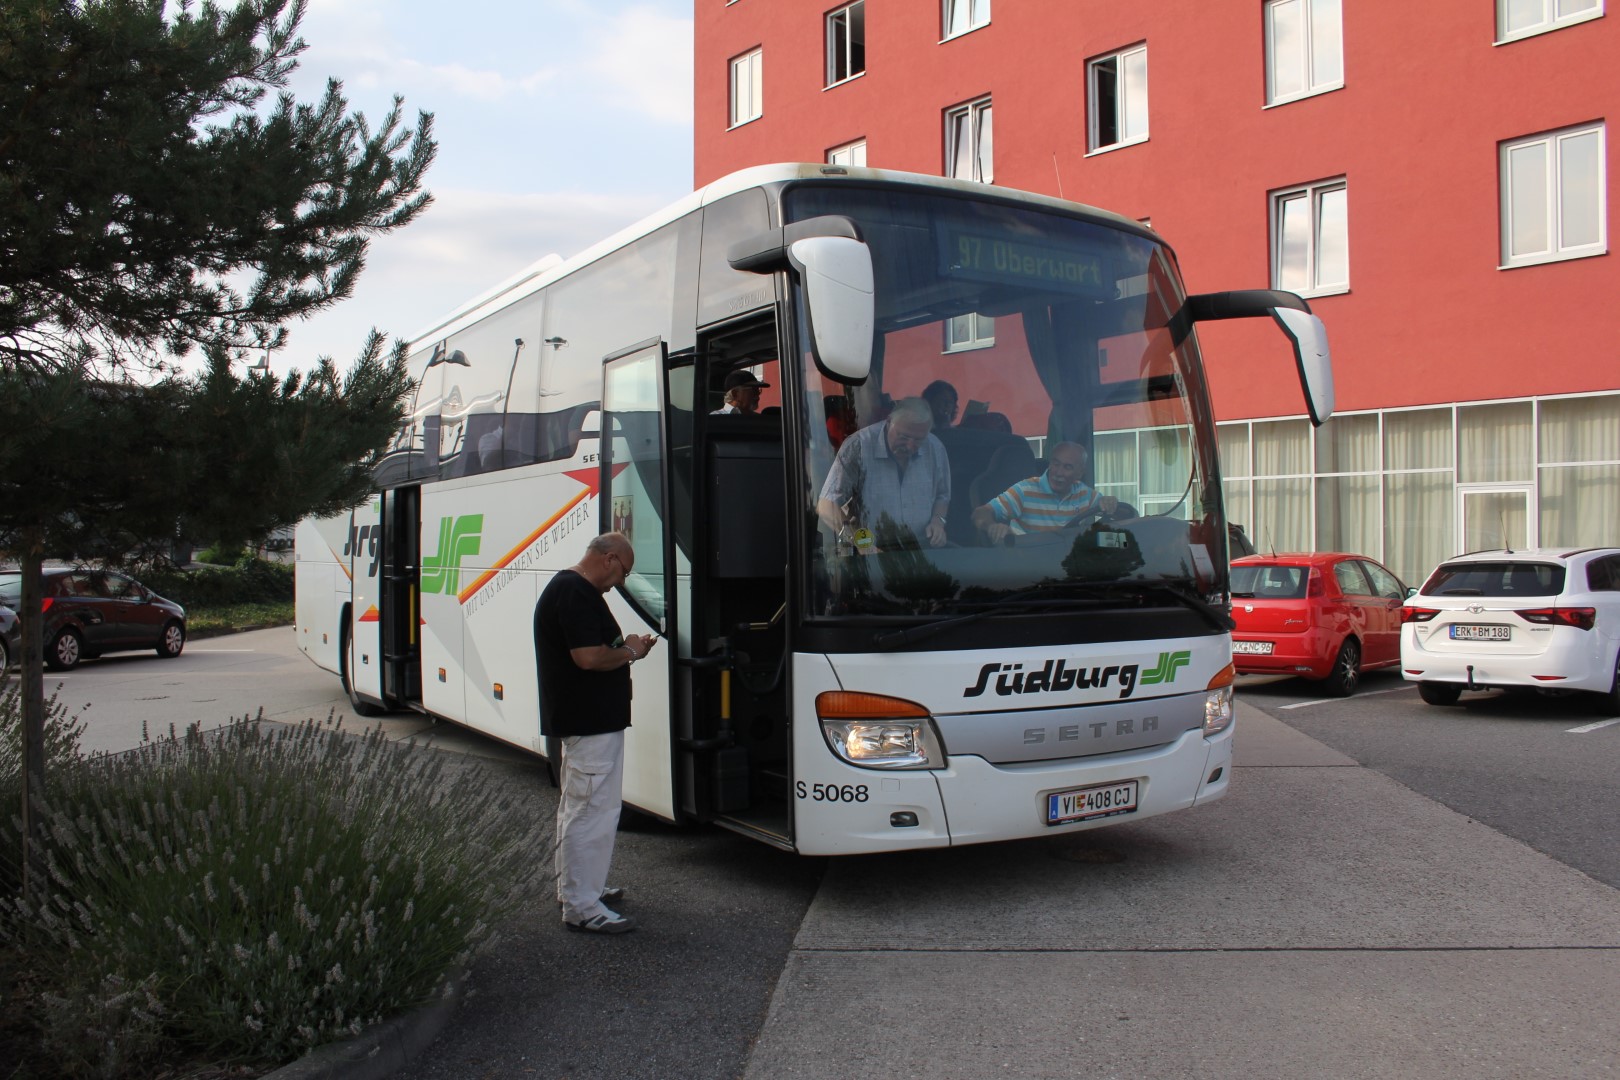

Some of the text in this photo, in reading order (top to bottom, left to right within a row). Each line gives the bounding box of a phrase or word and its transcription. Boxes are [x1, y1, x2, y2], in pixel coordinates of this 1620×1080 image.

[959, 235, 982, 269] 97
[465, 502, 589, 618] MIT UNS KOMMEN SIE WEITER
[1455, 626, 1509, 638] ERK BM 188
[1261, 643, 1271, 652] 96
[963, 659, 1139, 698] Südburg
[1024, 716, 1159, 745] SETRA
[796, 780, 869, 803] S 5068
[1063, 796, 1076, 815] VI
[1087, 790, 1111, 810] 408
